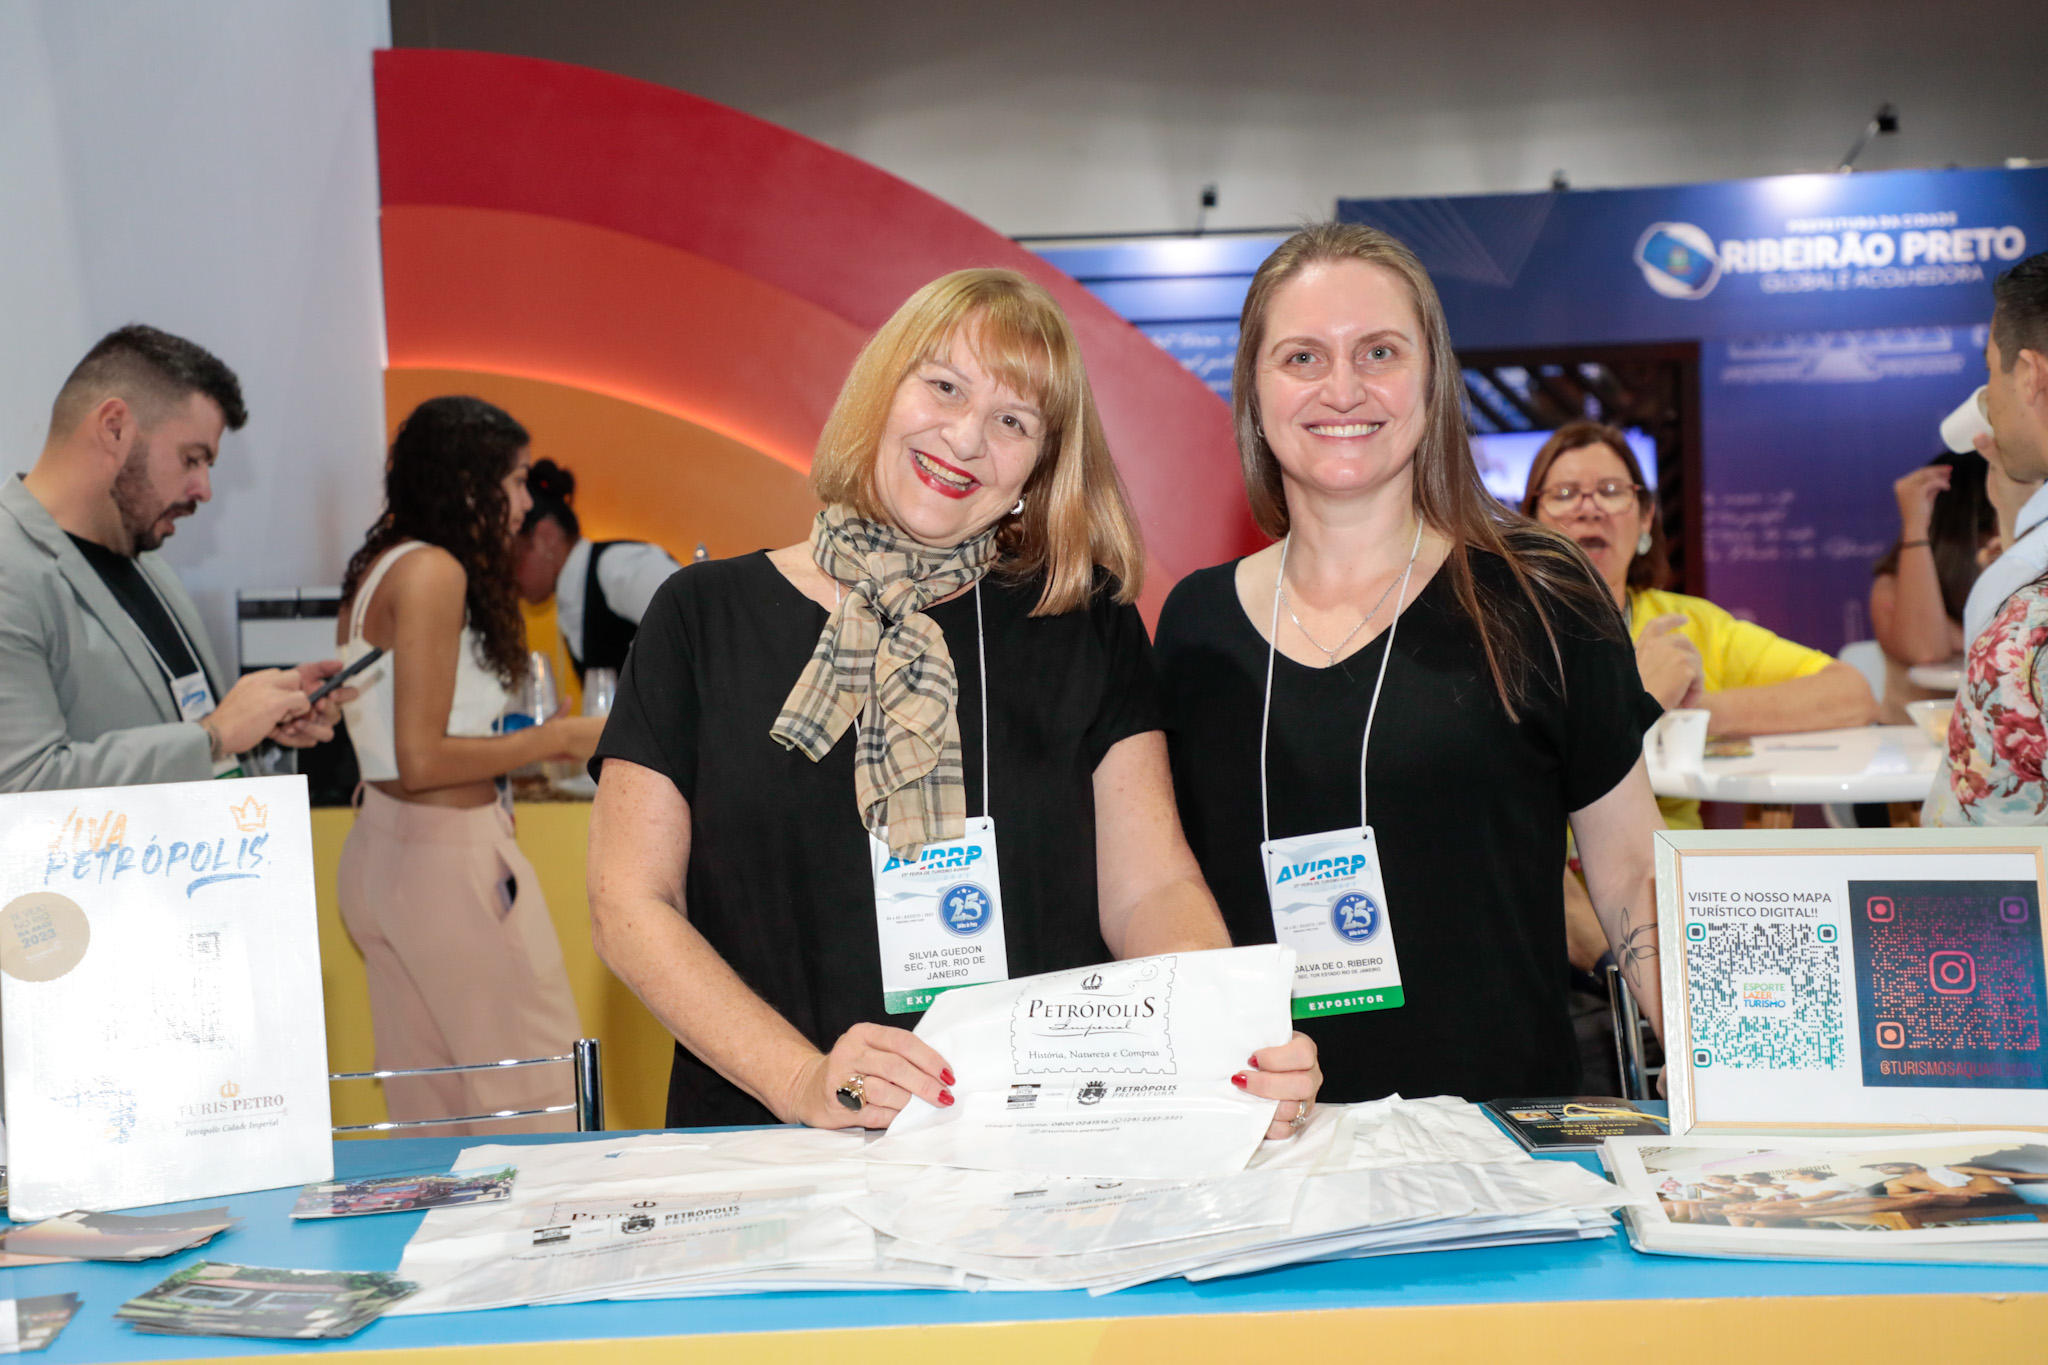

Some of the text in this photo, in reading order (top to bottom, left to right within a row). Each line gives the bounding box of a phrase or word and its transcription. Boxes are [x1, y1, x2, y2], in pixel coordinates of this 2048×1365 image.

[1721, 225, 2026, 275] RIBEIRÃO PRETO
[1760, 271, 1835, 294] GLOBAL
[1275, 854, 1366, 885] AVIRRP
[1688, 892, 1832, 903] VISITE O NOSSO MAPA
[949, 892, 982, 923] 25
[1340, 899, 1371, 930] 25
[1689, 905, 1818, 918] TURÍSTICO DIGITAL!!
[22, 928, 56, 949] 2023
[908, 945, 982, 960] SILVIA GUEDON
[904, 955, 986, 972] SEC. TUR. RIO DE
[1322, 962, 1334, 970] DE
[1336, 961, 1346, 969] O.
[1347, 957, 1383, 967] RIBEIRO
[926, 968, 969, 980] JANEIRO
[1743, 983, 1786, 991] ESPORTE
[1743, 991, 1772, 999] LAZER
[1028, 996, 1155, 1018] PETRÓPOLIS
[1309, 995, 1384, 1011] EXPOSITOR
[1744, 999, 1786, 1008] TURISMO
[1049, 1019, 1132, 1037] Imperial
[1028, 1050, 1067, 1060] História,
[1069, 1050, 1110, 1059] Natureza
[1120, 1049, 1160, 1060] Compras
[1112, 1090, 1175, 1098] PREFEITURA
[1115, 1084, 1178, 1092] PETRÓPOLIS
[186, 1119, 279, 1136] Petrópolis Cidade Imperial
[664, 1211, 740, 1226] PREFEITURA
[665, 1205, 740, 1221] PETRÓPOLIS
